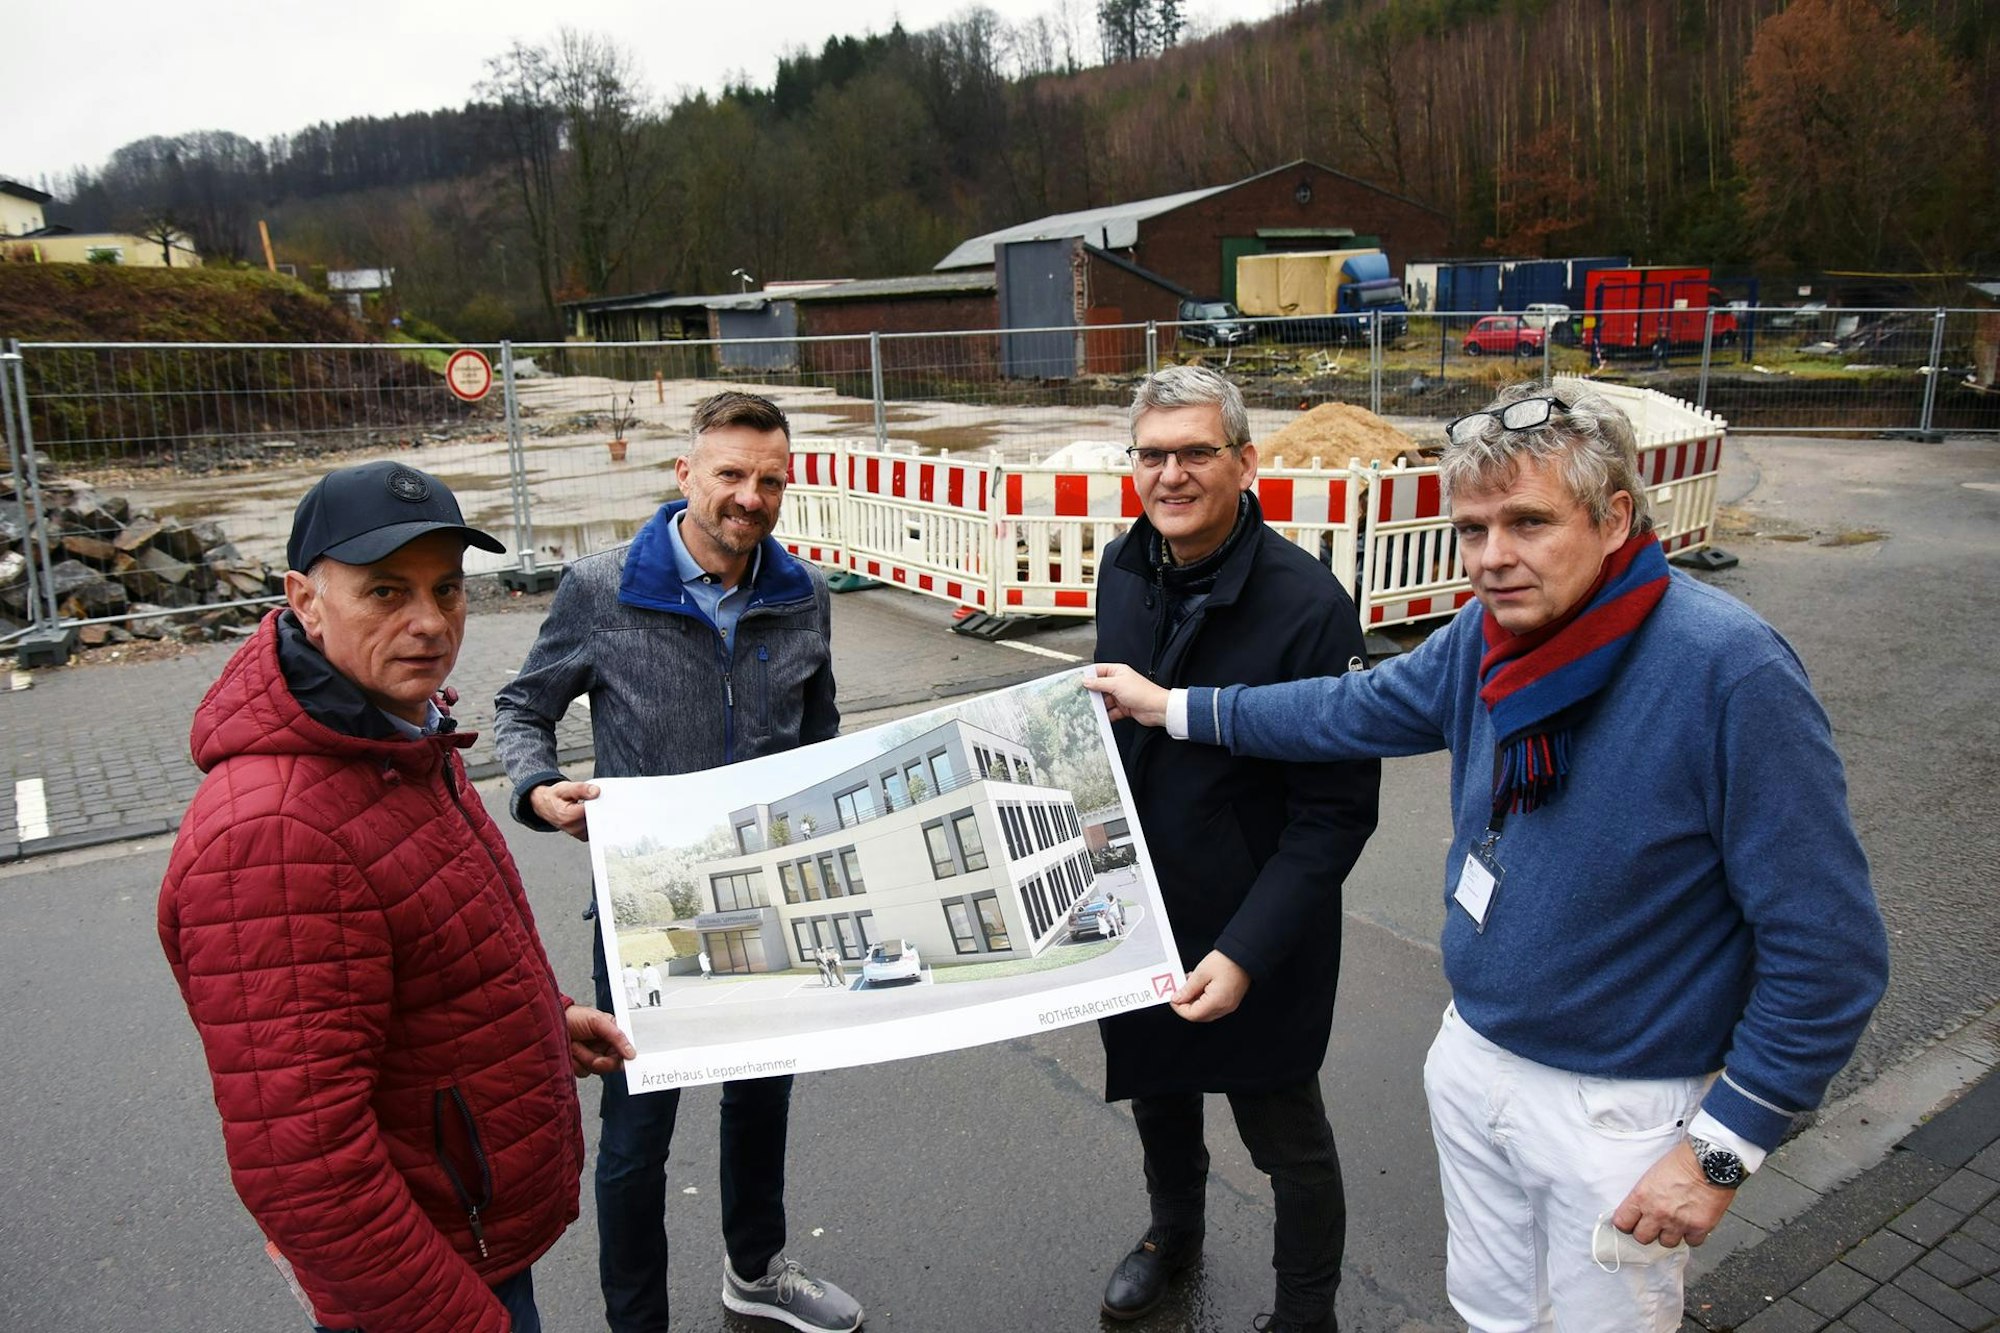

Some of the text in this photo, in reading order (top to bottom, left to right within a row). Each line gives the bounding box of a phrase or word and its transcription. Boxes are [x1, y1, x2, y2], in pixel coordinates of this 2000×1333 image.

[1038, 990, 1152, 1026] ROTHERARCHITEKTUR
[641, 1058, 798, 1087] Ärztehaus Lepperhammer
